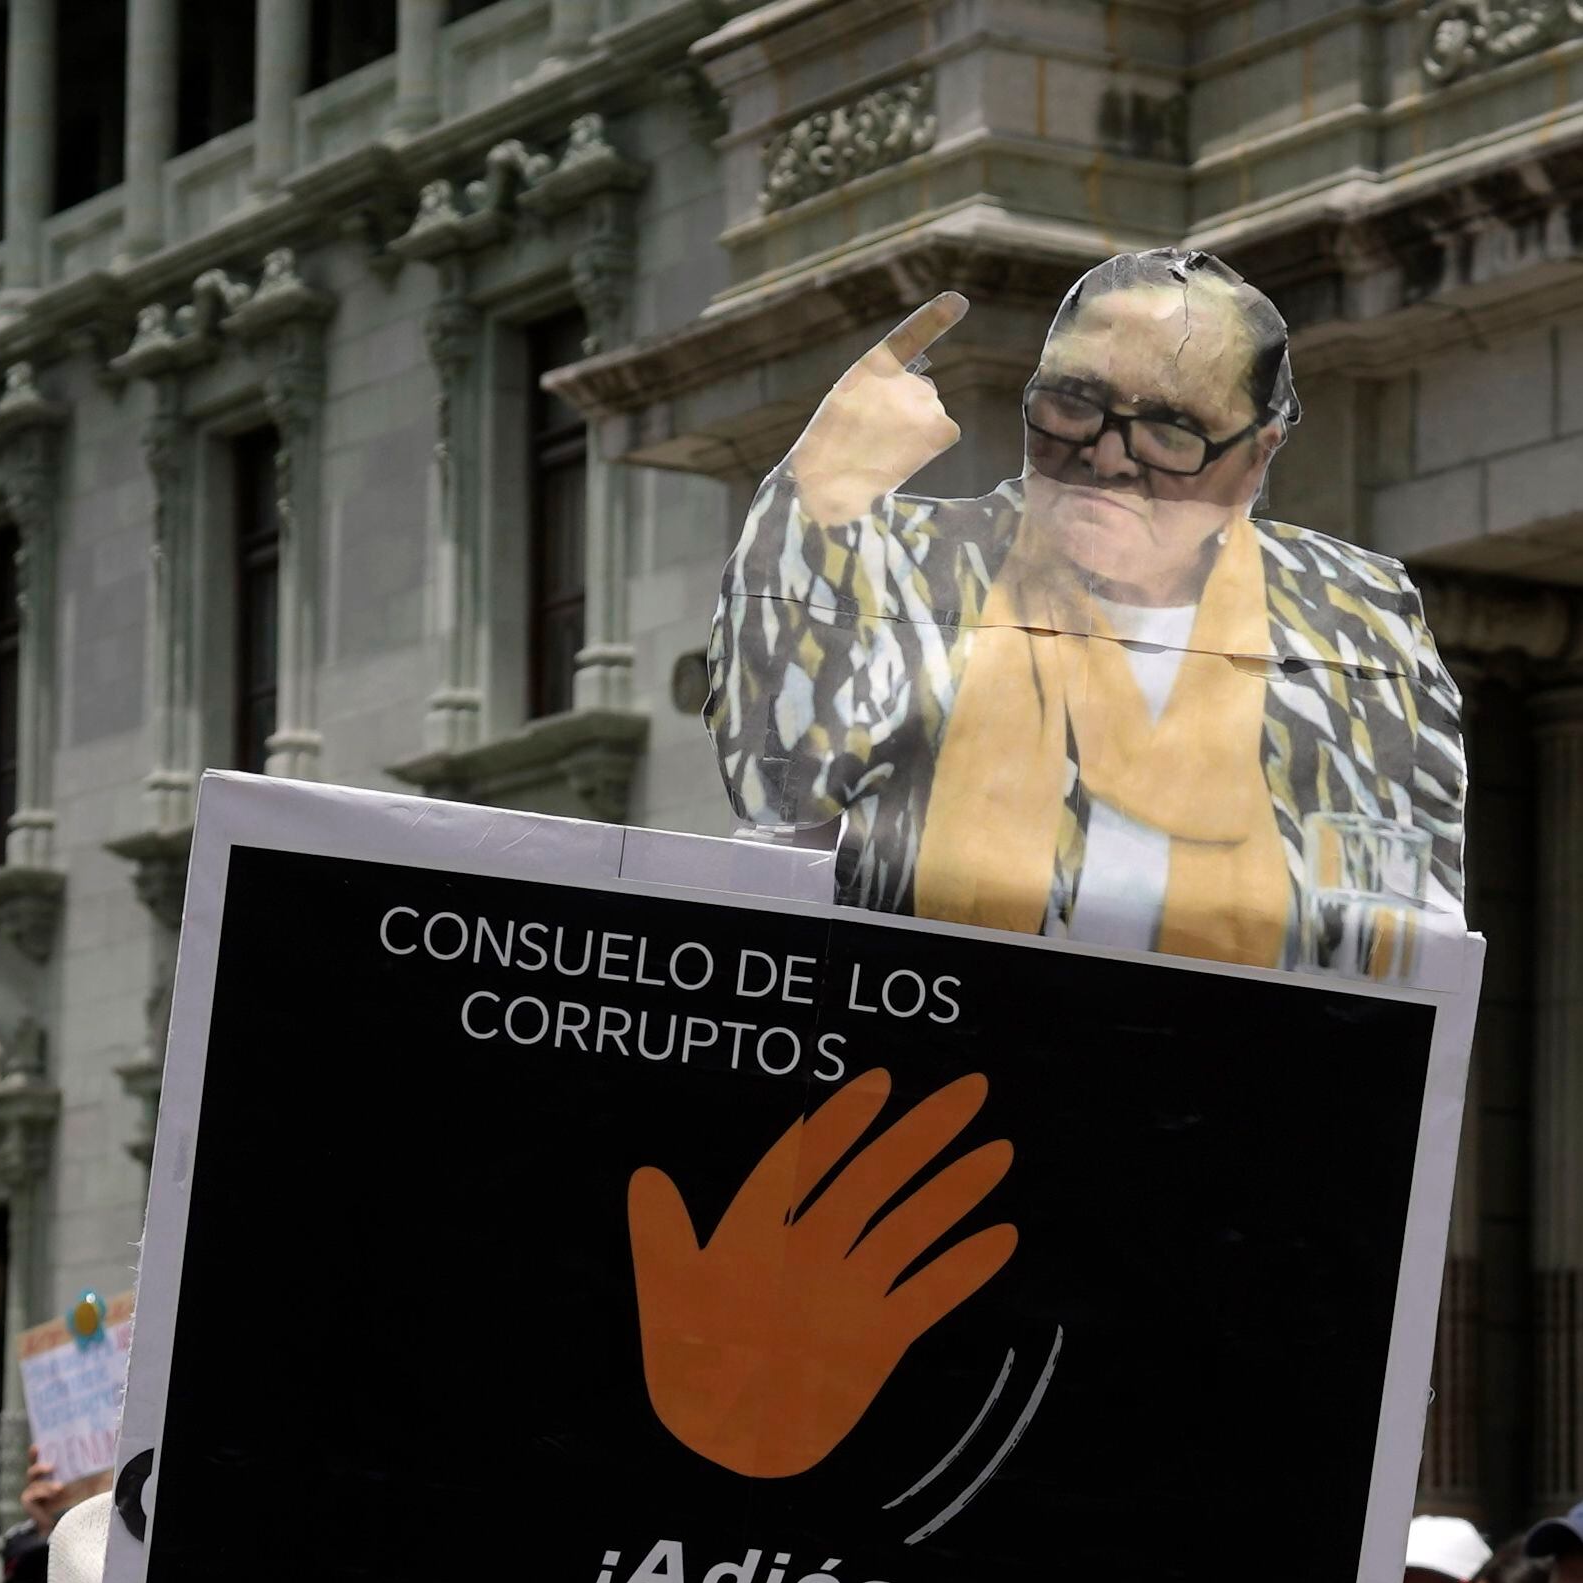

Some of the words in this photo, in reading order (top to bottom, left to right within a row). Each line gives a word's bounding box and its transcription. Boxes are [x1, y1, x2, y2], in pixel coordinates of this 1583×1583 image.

[377, 904, 716, 996] CONSUELO
[735, 944, 817, 1006] DE
[848, 962, 963, 1026] LOS
[459, 990, 849, 1083] CORRUPTOS
